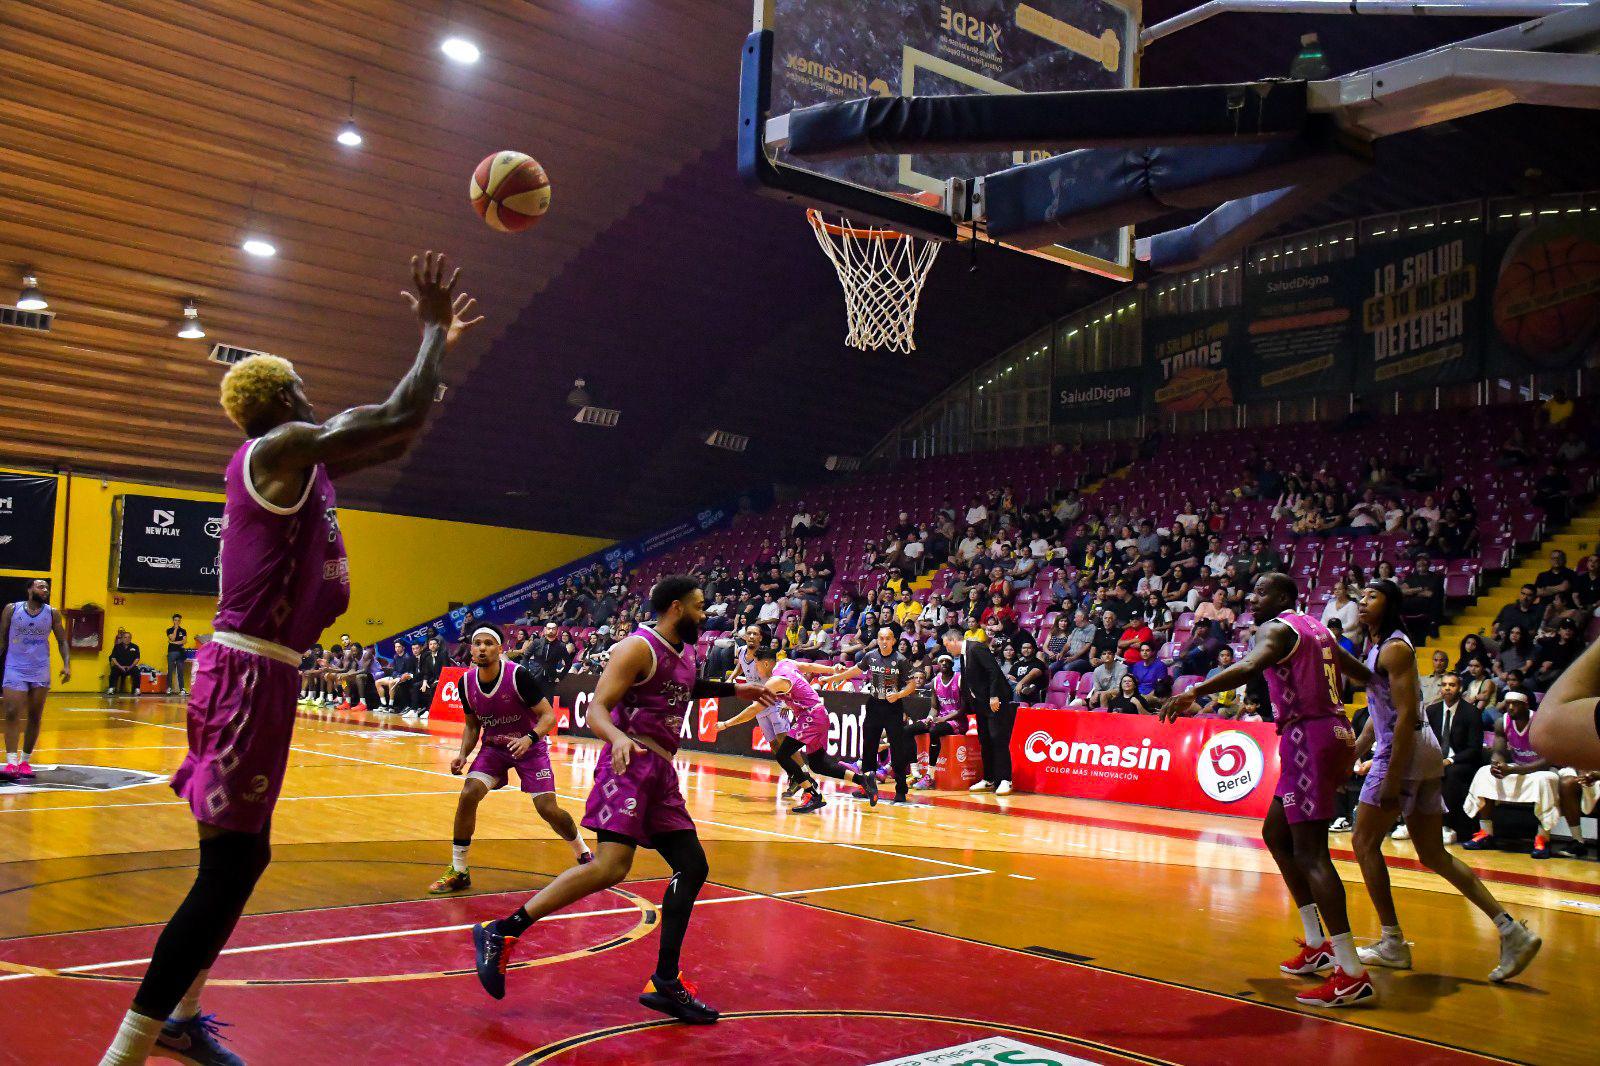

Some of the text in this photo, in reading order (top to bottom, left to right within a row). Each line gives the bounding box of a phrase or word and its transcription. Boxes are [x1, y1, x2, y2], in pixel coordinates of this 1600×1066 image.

[1267, 274, 1329, 293] SaludDigna
[1374, 298, 1465, 362] DEFENSA
[1060, 385, 1131, 404] SaludDigna
[145, 526, 181, 537] NEW PLAY
[1024, 730, 1171, 771] Comasin
[1045, 766, 1070, 774] COLOR
[1090, 771, 1139, 781] INNOVACIÓN
[1217, 770, 1252, 793] Berel
